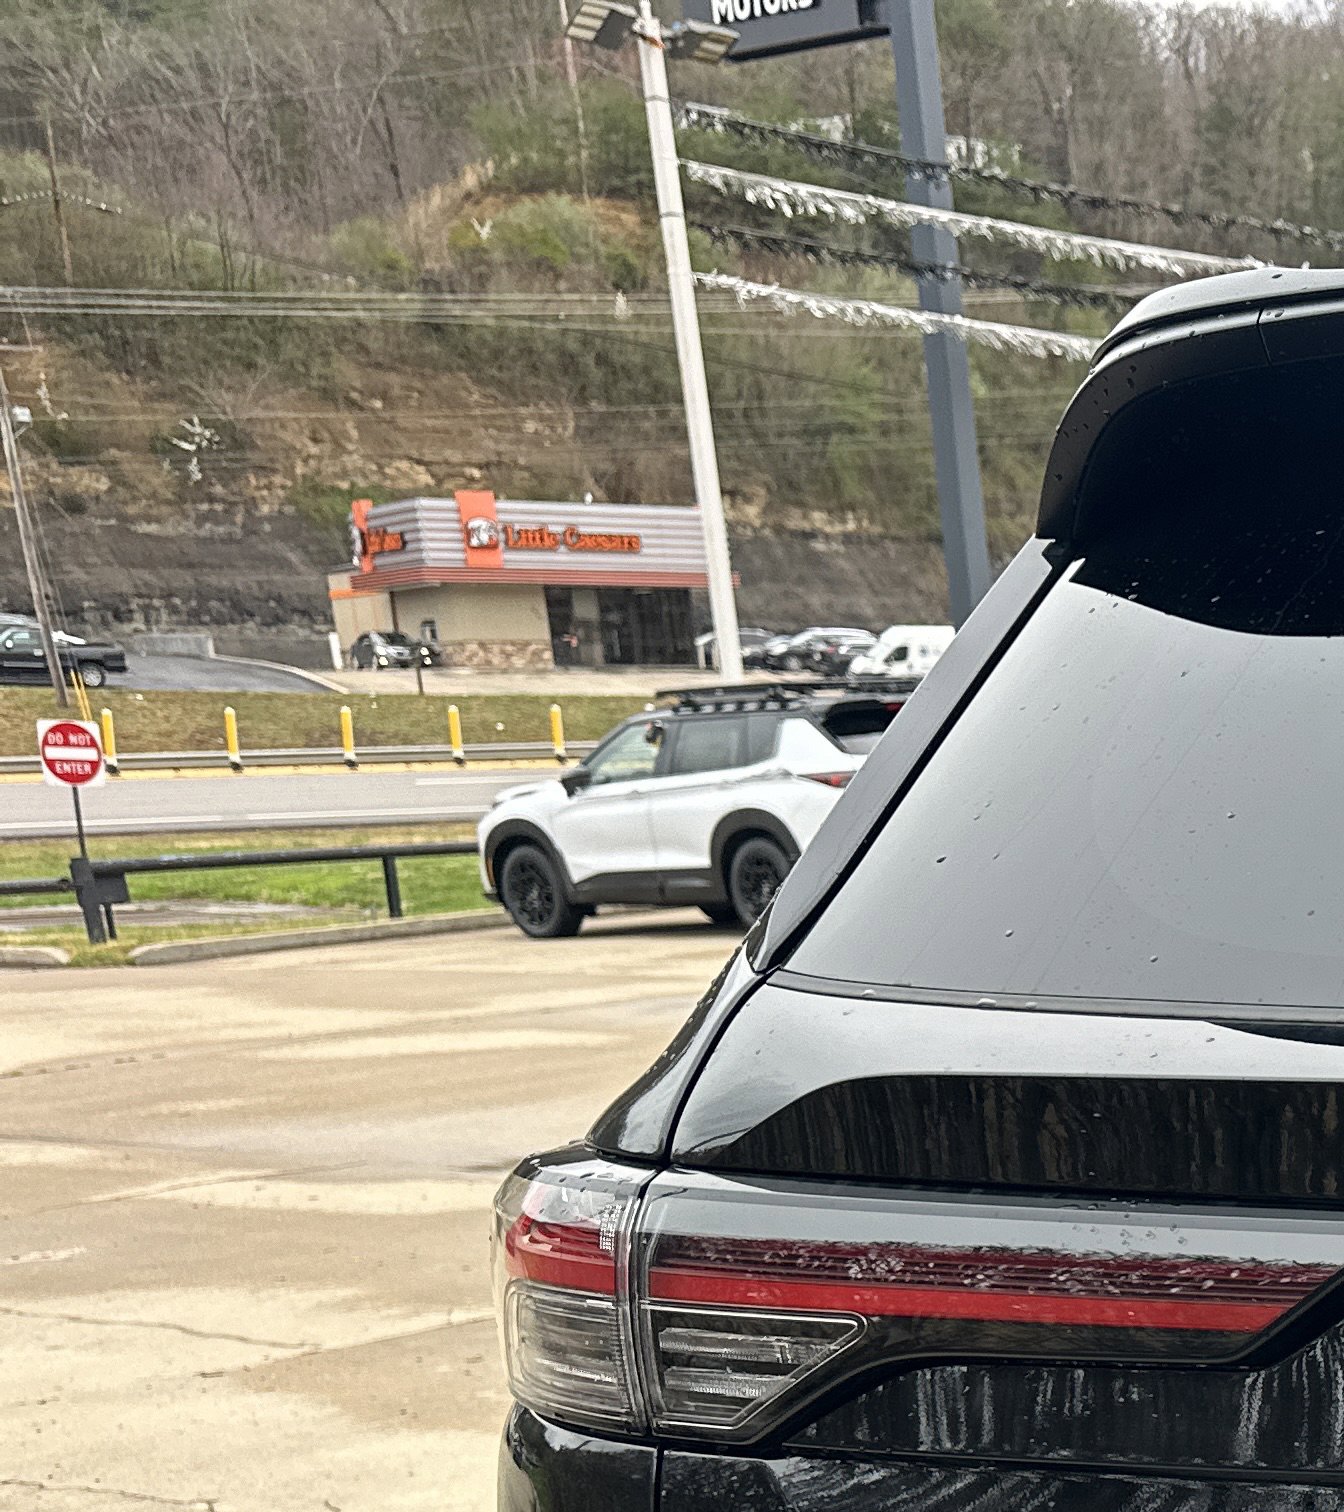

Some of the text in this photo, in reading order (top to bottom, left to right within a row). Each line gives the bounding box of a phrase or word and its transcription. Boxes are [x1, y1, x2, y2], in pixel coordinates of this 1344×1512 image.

[503, 523, 642, 553] Little Caesars
[47, 731, 91, 746] DO NOT
[55, 761, 92, 775] ENTER
